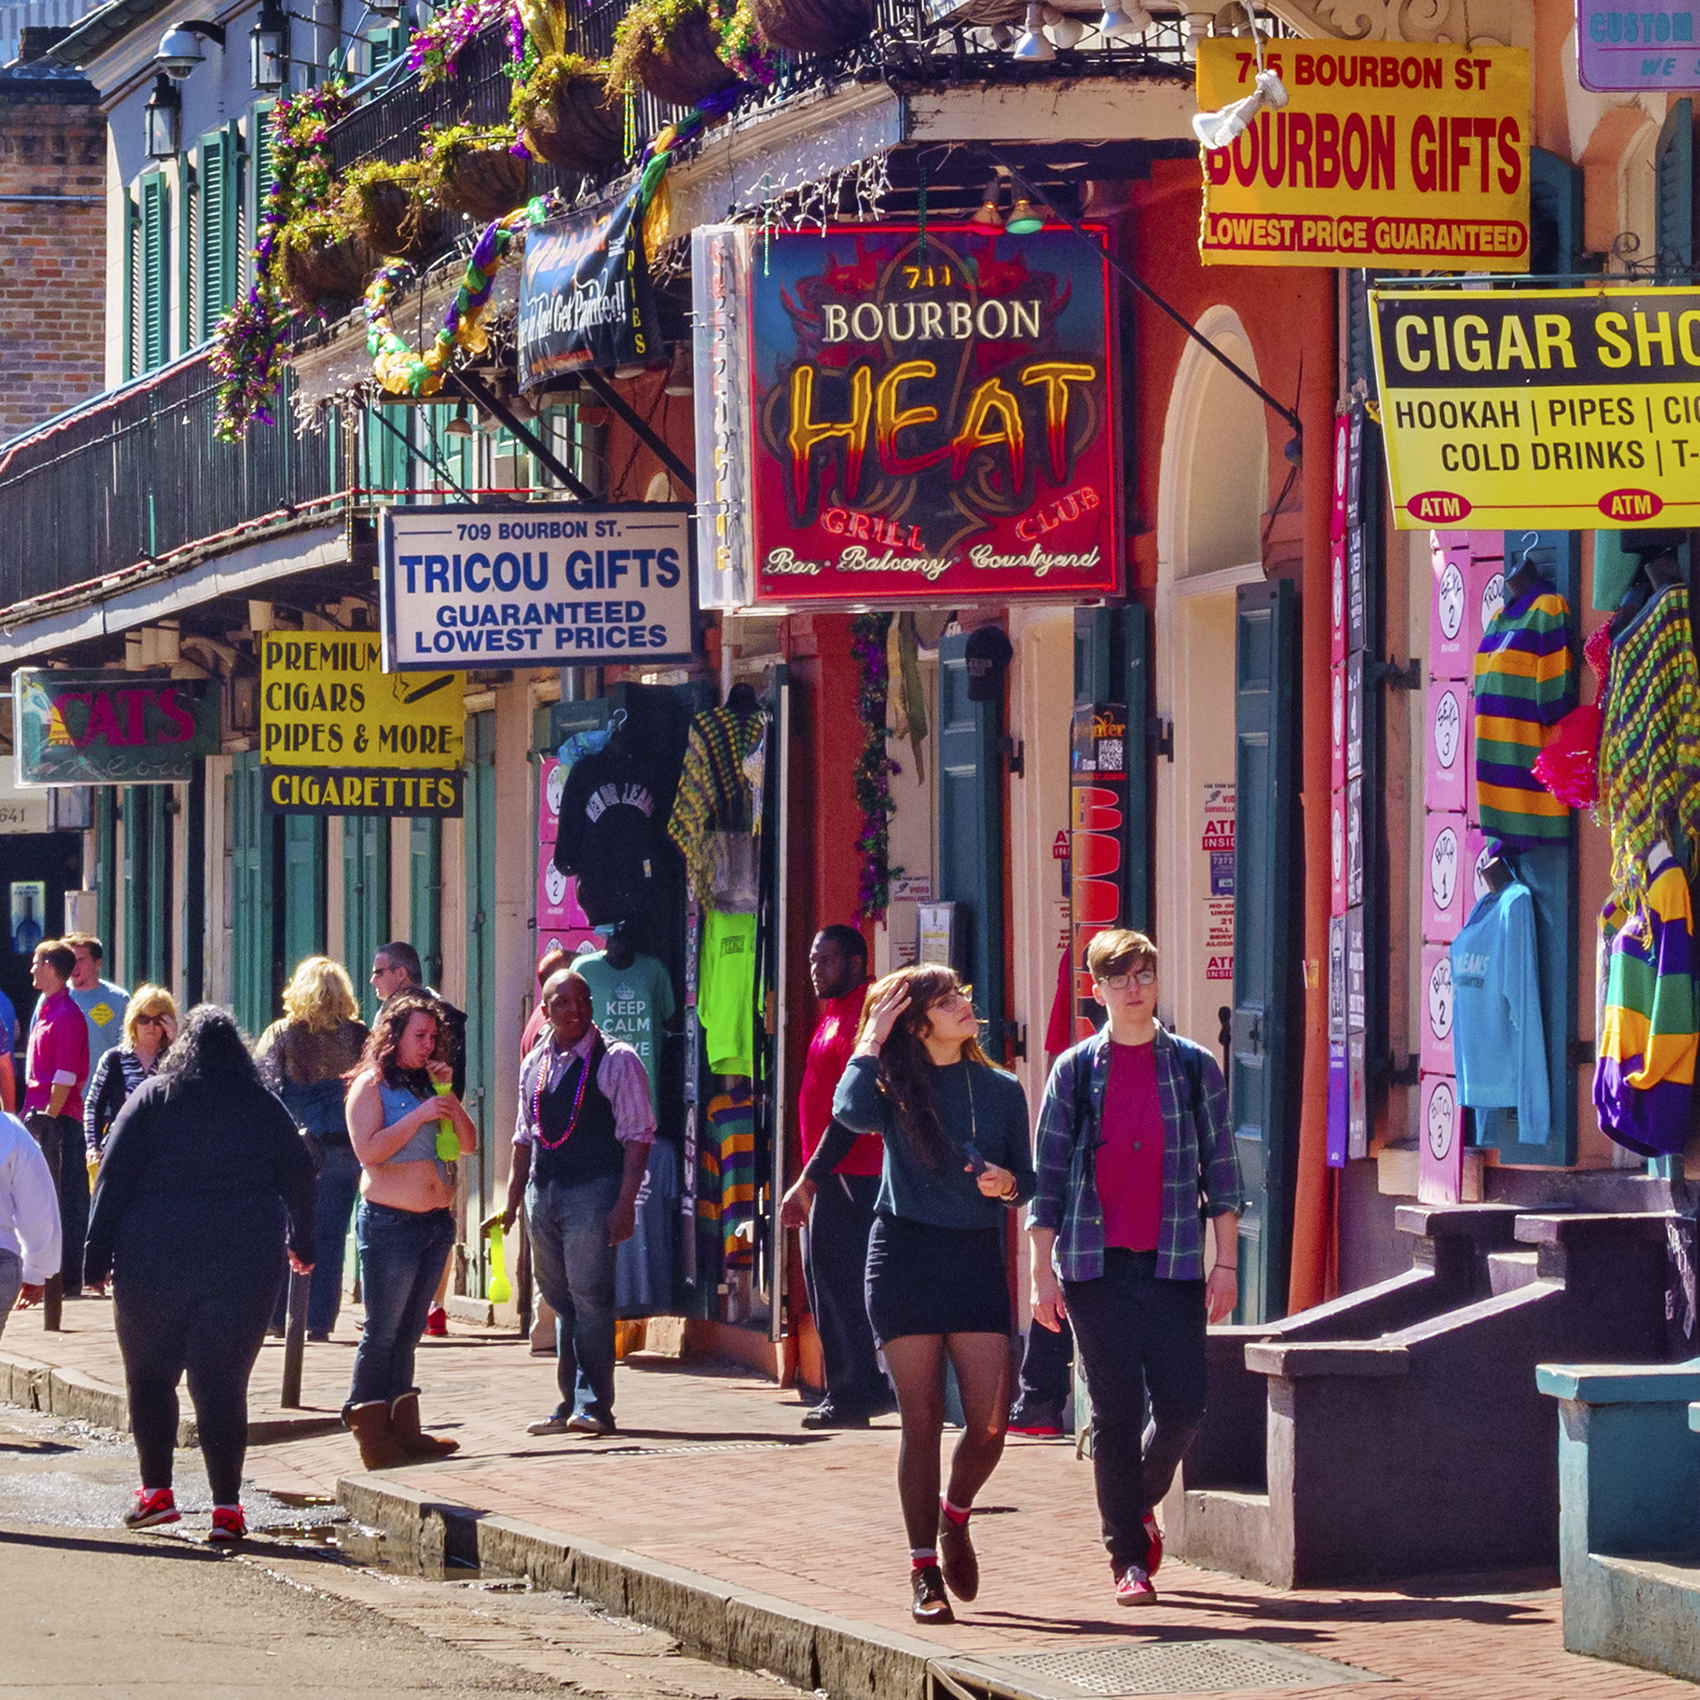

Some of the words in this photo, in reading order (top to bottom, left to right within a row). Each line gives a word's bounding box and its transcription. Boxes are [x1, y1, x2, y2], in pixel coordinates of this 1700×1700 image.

[1589, 11, 1693, 43] CUSTOM
[1295, 54, 1443, 89] BOURBON
[1455, 58, 1491, 90] ST
[1640, 56, 1677, 77] WE
[1410, 114, 1522, 194] GIFTS
[1205, 217, 1294, 247] LOWEST
[1302, 220, 1367, 249] PRICE
[1375, 221, 1523, 252] GUARANTEED
[904, 265, 952, 289] 711
[822, 299, 1042, 343] BOURBON
[1395, 312, 1577, 373] CIGAR
[1396, 399, 1520, 430] HOOKAH
[1549, 397, 1636, 427] PIPES
[789, 360, 1096, 517] HEAT
[1442, 442, 1520, 472] COLD
[1533, 439, 1645, 470] DRINKS
[1014, 486, 1101, 542] CLUB
[1420, 497, 1460, 517] ATM
[1611, 495, 1651, 516] ATM
[457, 523, 491, 541] 709
[498, 521, 588, 540] BOURBON
[595, 520, 622, 538] ST.
[821, 507, 927, 552] GRILL
[398, 551, 548, 593] TRICOU
[565, 548, 680, 591] GIFTS
[763, 547, 821, 577] Bar
[836, 545, 953, 581] Balcony
[436, 601, 646, 627] GUARANTEED
[415, 628, 543, 654] LOWEST
[555, 624, 667, 650] PRICES
[266, 682, 366, 713] CIGARS
[50, 688, 196, 748] CATS
[265, 723, 343, 753] PIPES
[353, 724, 369, 753] &
[379, 724, 453, 753] MORE
[271, 774, 456, 808] CIGARETTES
[1434, 835, 1455, 865] BITCH
[606, 1001, 646, 1015] KEEP
[602, 1018, 650, 1032] CALM
